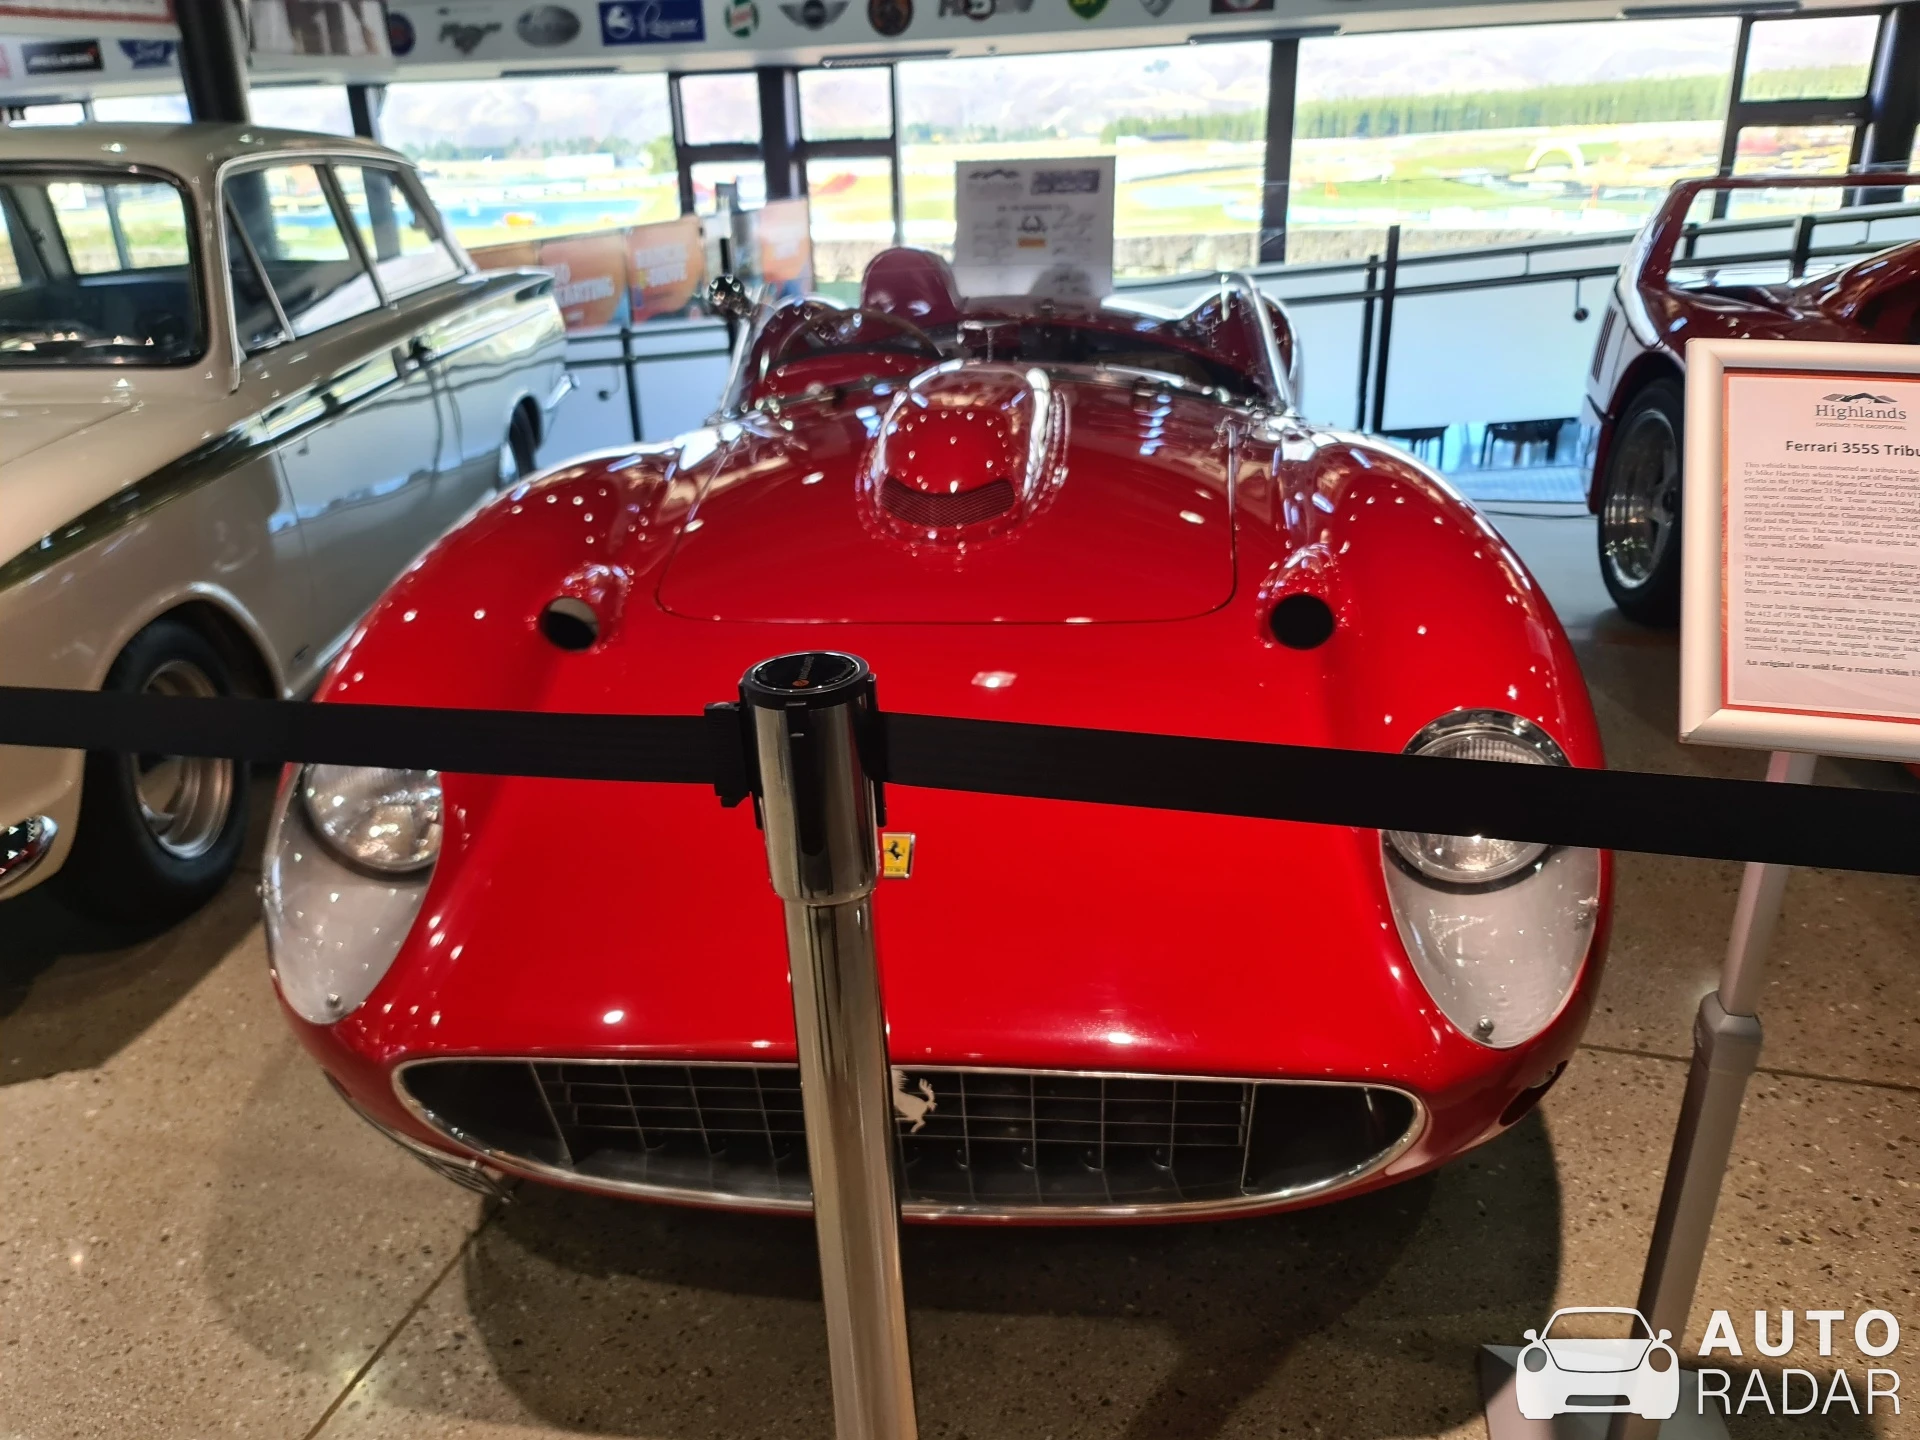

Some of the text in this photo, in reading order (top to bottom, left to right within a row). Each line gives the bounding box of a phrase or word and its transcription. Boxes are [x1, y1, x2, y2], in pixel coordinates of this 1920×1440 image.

[1815, 404, 1907, 420] Highlands
[1786, 440, 1920, 457] Ferrari 355S Tribu
